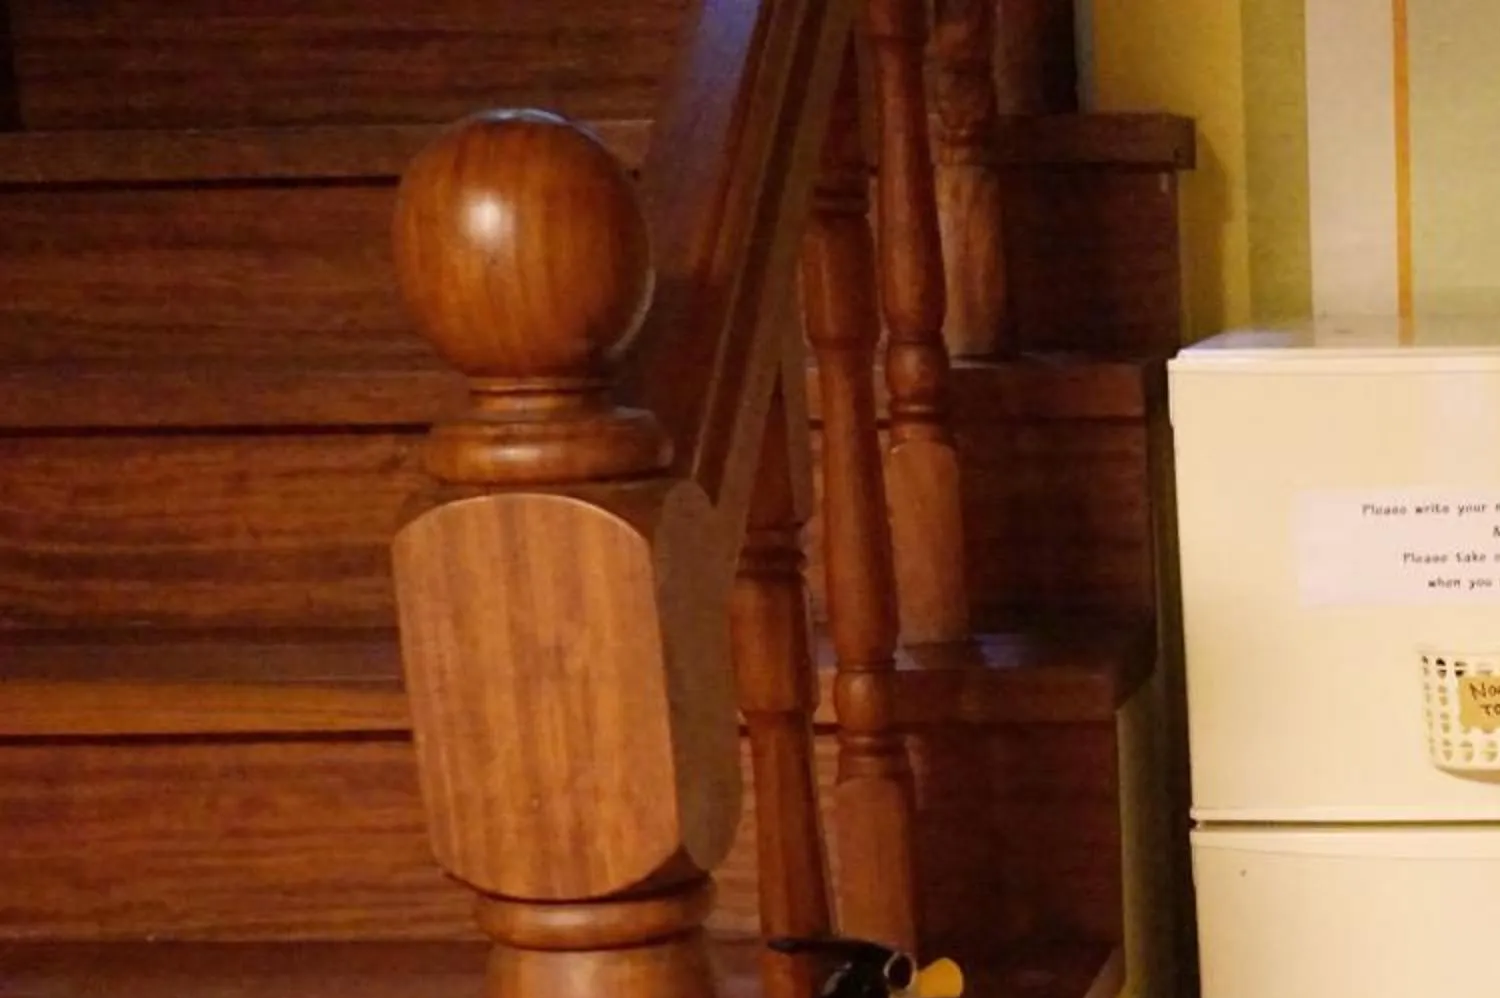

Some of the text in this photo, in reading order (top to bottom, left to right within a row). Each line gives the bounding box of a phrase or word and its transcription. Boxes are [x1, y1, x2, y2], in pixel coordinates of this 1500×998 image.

[1361, 503, 1408, 516] Please
[1414, 502, 1451, 514] write
[1457, 502, 1487, 518] your
[1402, 551, 1449, 565] Please
[1455, 550, 1487, 563] take
[1427, 576, 1461, 588] when
[1467, 578, 1493, 591] you
